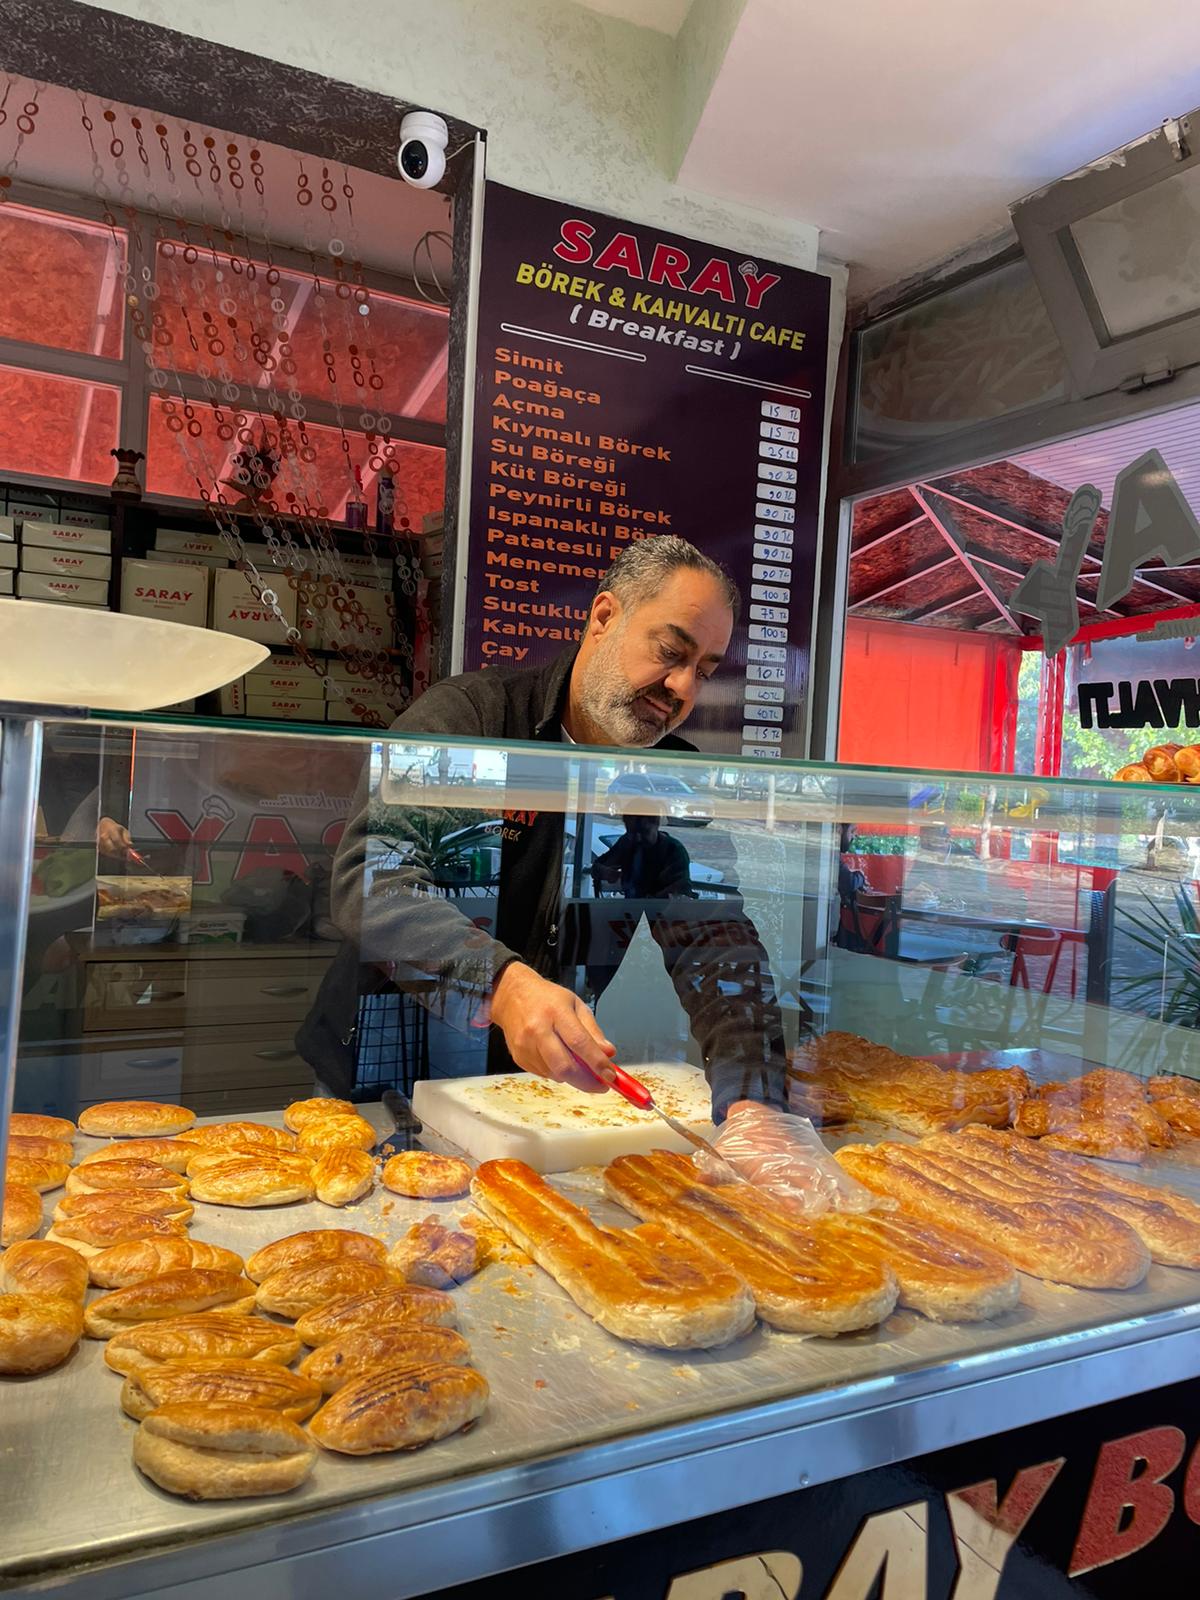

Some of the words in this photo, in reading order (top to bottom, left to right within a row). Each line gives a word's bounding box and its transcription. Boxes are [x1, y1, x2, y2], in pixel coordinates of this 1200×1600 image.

[553, 219, 781, 309] SARAY
[516, 262, 605, 303] BÖREK
[608, 287, 626, 308] &
[631, 292, 745, 337] KAHVALTI
[749, 324, 807, 351] CAFE
[588, 309, 725, 349] Breakfast
[495, 347, 564, 375] Simit
[495, 369, 601, 404] Poağaça
[492, 393, 565, 420] Açma
[769, 405, 780, 417] 15
[492, 415, 591, 447] Kıymalı
[599, 435, 672, 462] Börek
[769, 427, 782, 438] 15
[490, 438, 524, 457] Su
[532, 445, 616, 474] Böreği
[768, 447, 784, 459] 25
[490, 460, 536, 481] Küt
[543, 470, 627, 497] Böreği
[489, 483, 592, 513] Peynirli
[600, 501, 672, 526] Börek
[488, 505, 607, 537] Ispanaklı
[52, 530, 84, 539] SARAY
[488, 528, 602, 558] Patatesli
[53, 557, 84, 565] SARAY
[48, 582, 80, 591] SARAY
[485, 573, 539, 593] Tost
[134, 587, 194, 602] SARAY
[762, 590, 778, 600] 100
[483, 596, 588, 620] Sucuklu
[761, 608, 774, 620] 75
[483, 619, 581, 642] Kahvalt
[761, 627, 778, 638] 100
[481, 641, 530, 661] Çay
[757, 667, 772, 679] 10
[270, 680, 300, 688] SARAY
[272, 701, 301, 709] SARAY
[1067, 1425, 1200, 1578] B
